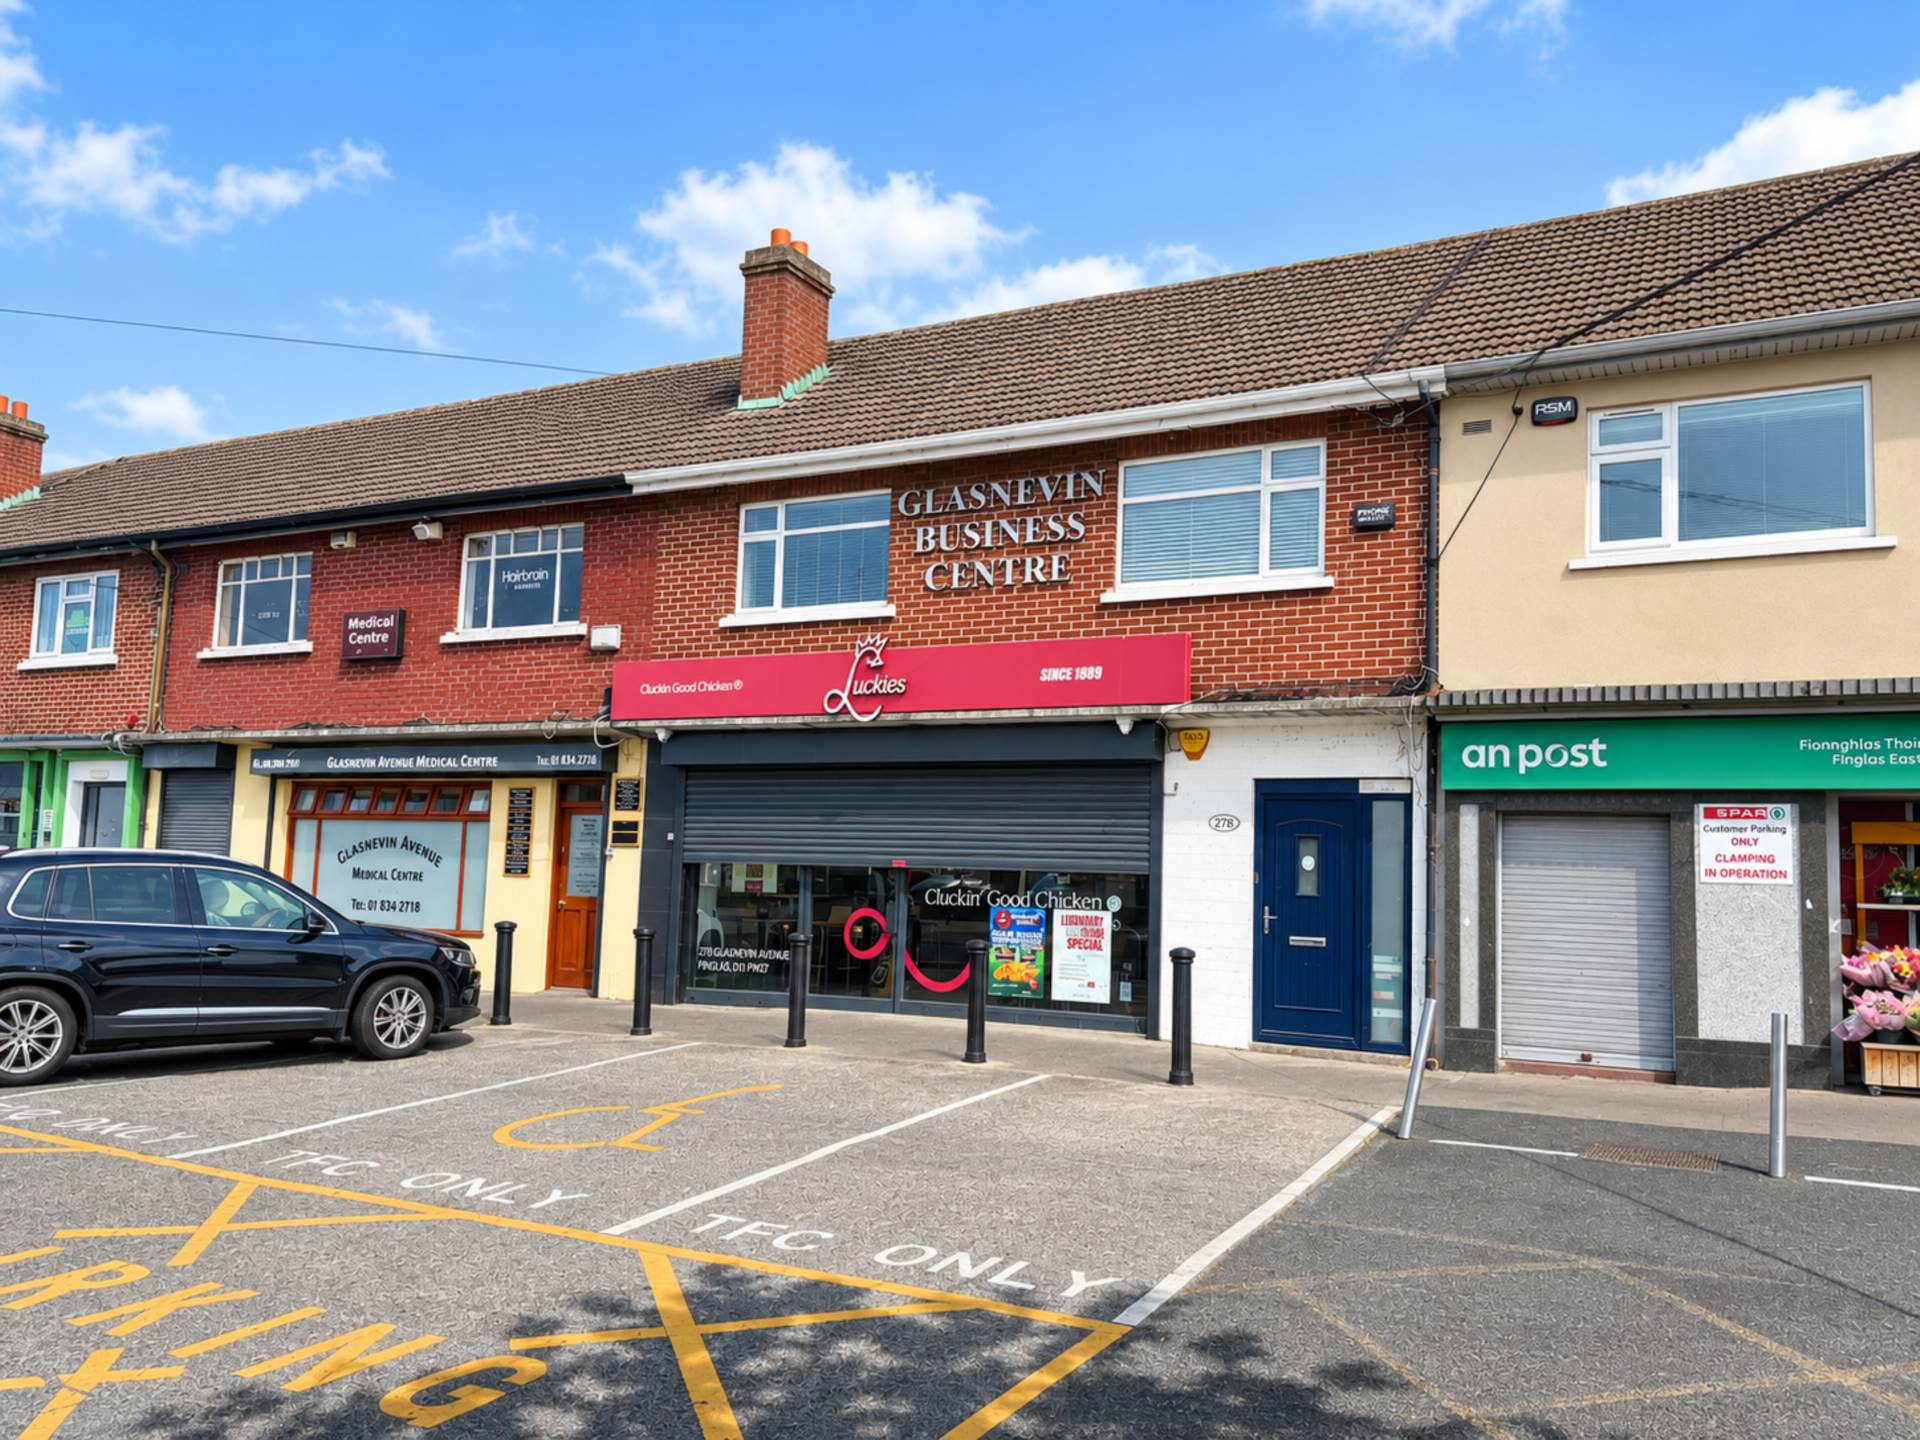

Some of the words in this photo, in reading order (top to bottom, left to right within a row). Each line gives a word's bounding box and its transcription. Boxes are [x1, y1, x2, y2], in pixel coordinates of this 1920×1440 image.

[1535, 400, 1572, 416] RSM
[898, 468, 1106, 517] GLASNEVIN
[914, 511, 1086, 554] BUSINESS
[502, 568, 549, 583] Hairbrain
[924, 553, 1072, 591] CENTRE
[348, 614, 394, 630] Medical
[348, 630, 389, 645] Centre
[1039, 667, 1073, 682] SINCE
[671, 681, 697, 693] Good
[823, 645, 906, 722] Luckies
[1799, 738, 1881, 753] Fionnghlas
[378, 755, 415, 769] AVENUE
[415, 754, 458, 769] MEDICAL
[460, 754, 498, 768] CENTRE
[1461, 743, 1510, 768] an
[1517, 737, 1608, 774] post
[1832, 753, 1886, 768] Finglas
[1716, 808, 1767, 818] SPAR
[1703, 824, 1748, 833] Customer
[1751, 824, 1787, 835] Parking
[1731, 837, 1759, 847] ONLY
[337, 836, 398, 864] GLASNEVIN
[399, 835, 443, 868] AVENUE
[1715, 853, 1776, 864] CLAMPING
[352, 867, 388, 880] MEDICAL
[391, 868, 424, 882] CENTRE
[1705, 868, 1717, 878] IN
[1720, 868, 1787, 880] OPERATION
[367, 900, 378, 912] 01
[380, 900, 397, 913] 834
[987, 889, 1031, 908] Good
[1034, 890, 1102, 910] Chicken
[1066, 937, 1104, 952] SPECIAL
[263, 1149, 380, 1177] TFC
[400, 1171, 592, 1209] ONLY
[691, 1213, 834, 1251] TFC
[873, 1243, 1125, 1299] ONLY
